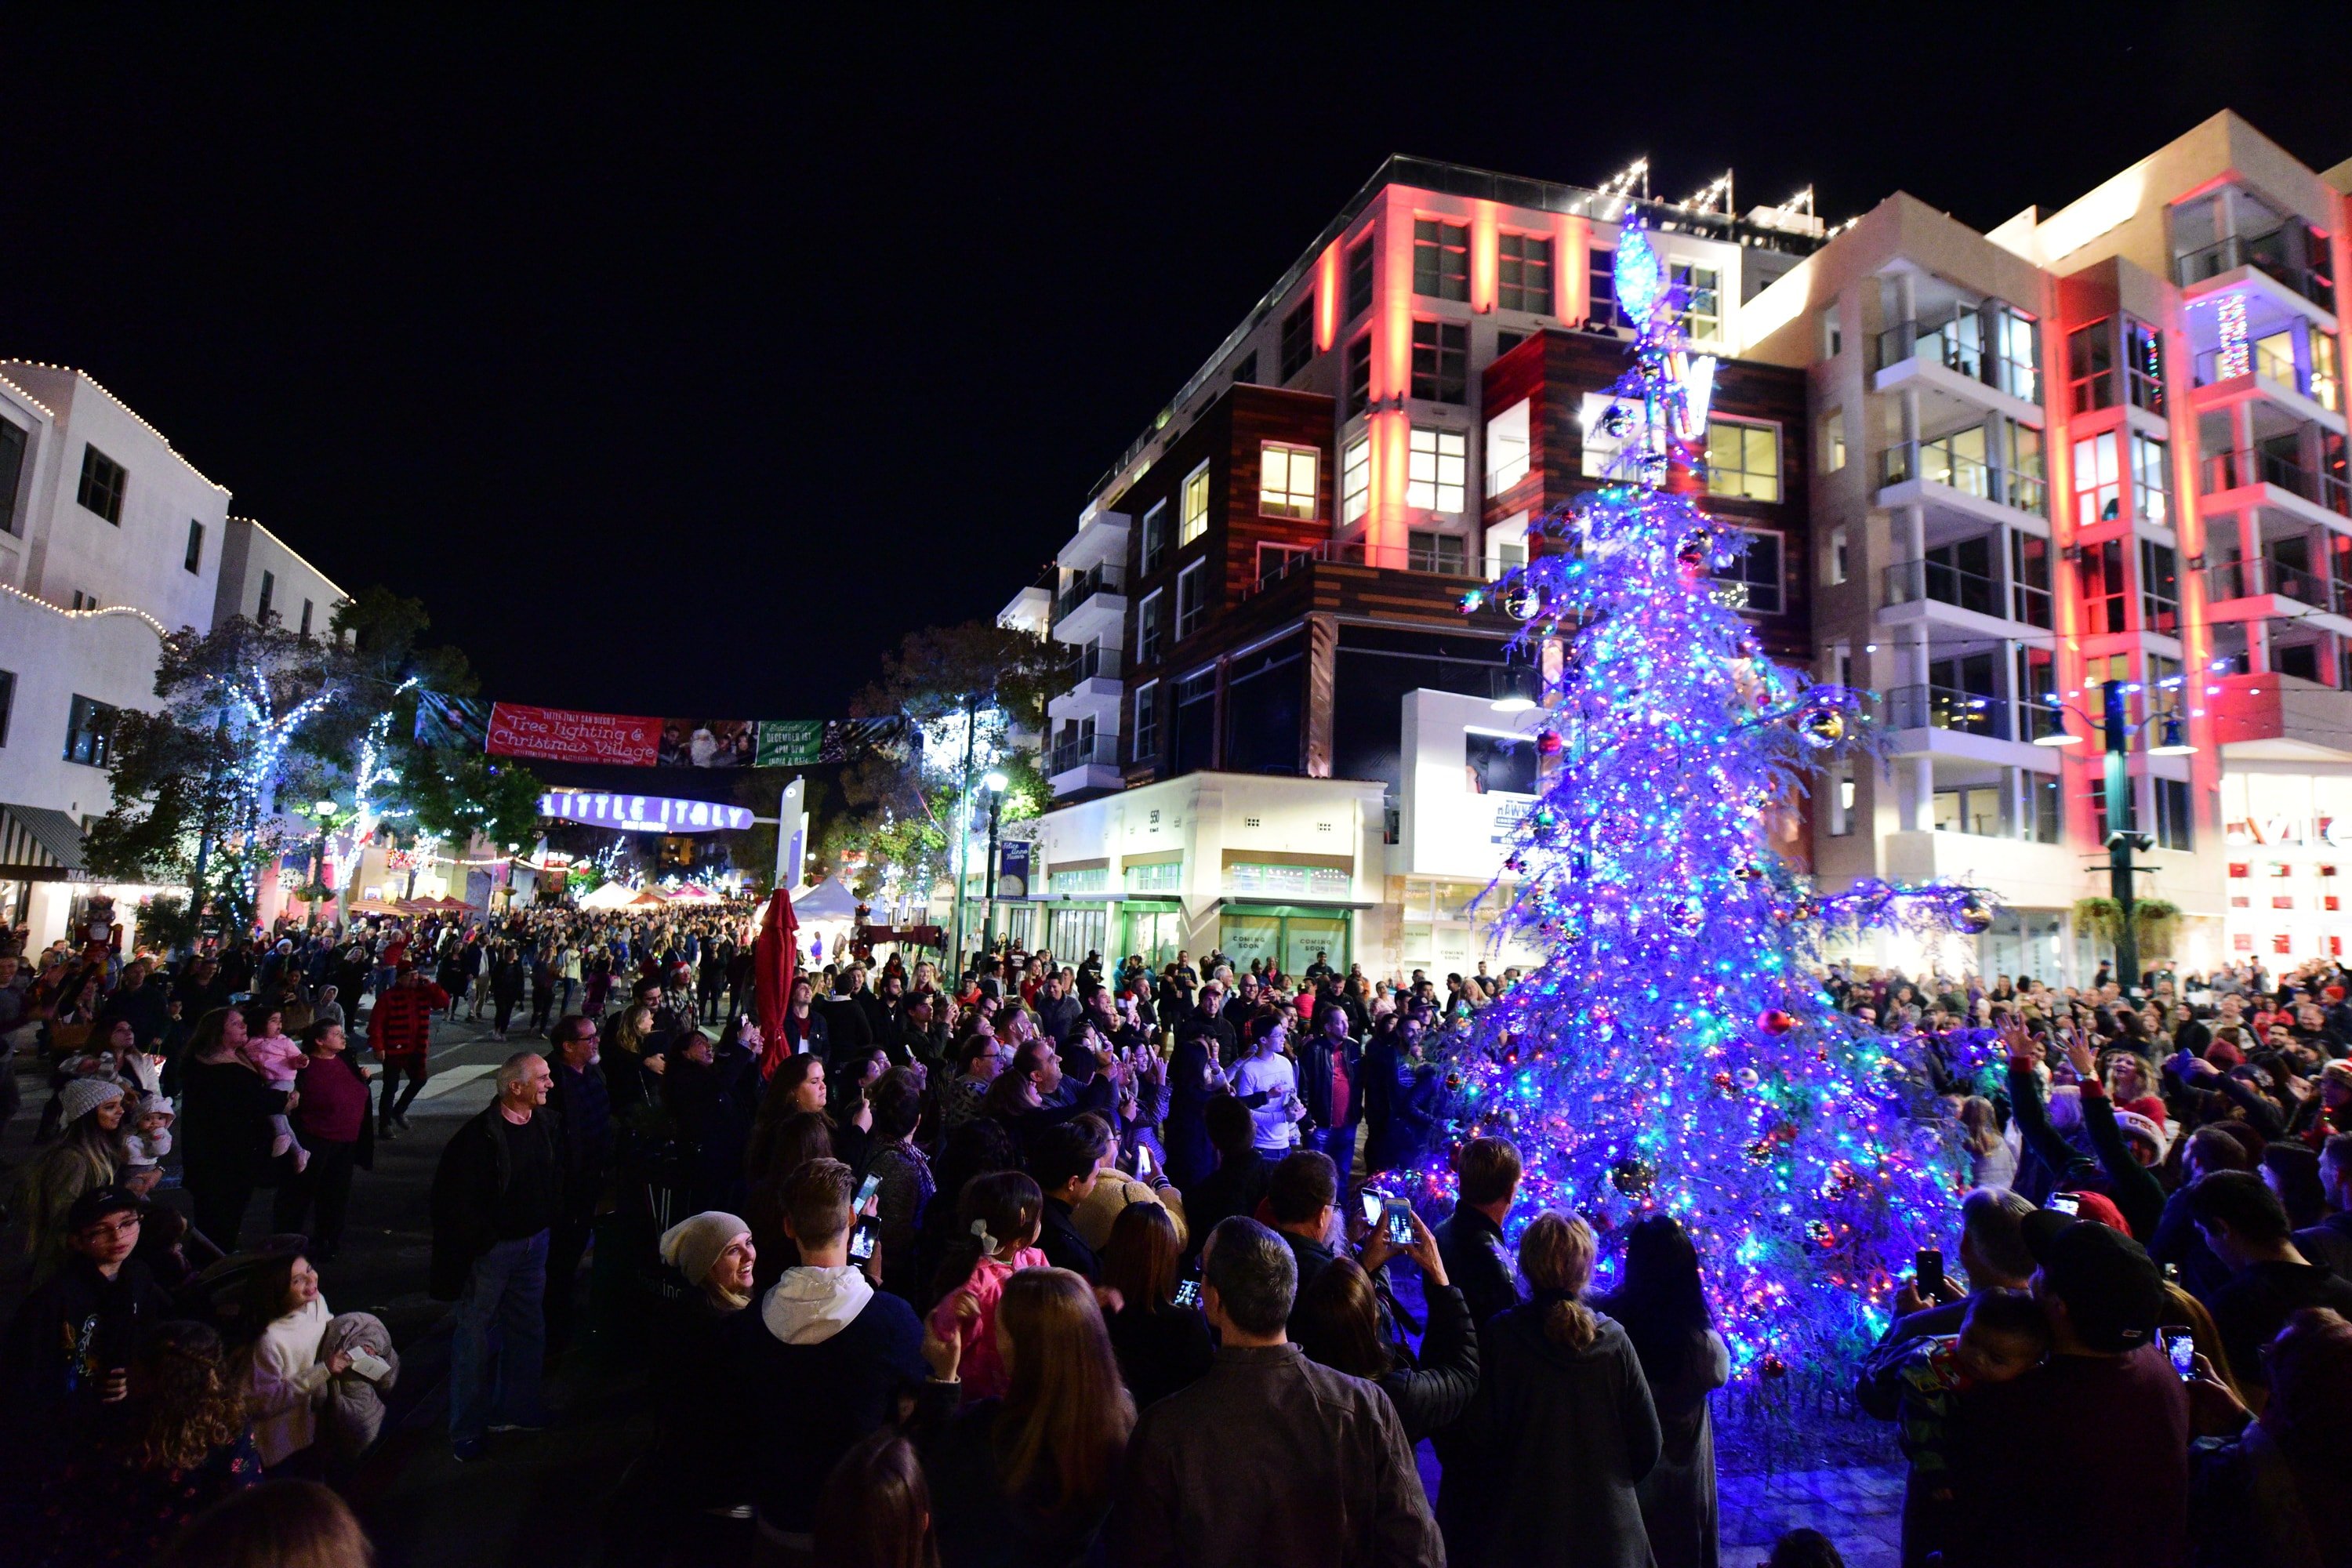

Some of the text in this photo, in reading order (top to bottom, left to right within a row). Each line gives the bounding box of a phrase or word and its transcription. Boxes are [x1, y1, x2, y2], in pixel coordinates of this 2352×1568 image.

[564, 713, 579, 722] ITALY
[507, 714, 644, 744] Tree Lighting &
[767, 732, 800, 742] DECEMBER
[493, 729, 655, 762] Christmas Village
[768, 757, 786, 766] INDIA
[543, 795, 742, 828] LITTLE ITALY
